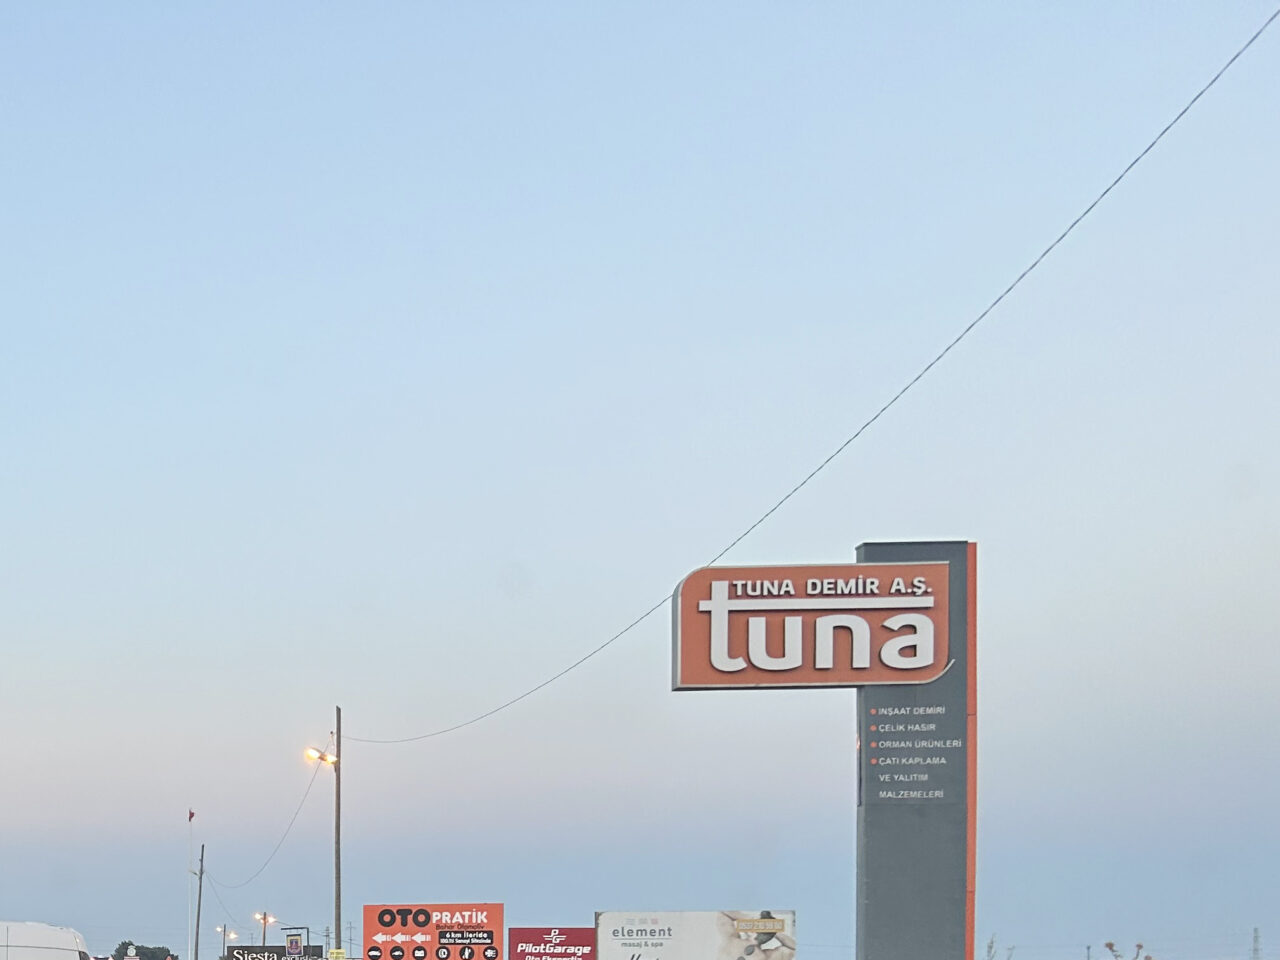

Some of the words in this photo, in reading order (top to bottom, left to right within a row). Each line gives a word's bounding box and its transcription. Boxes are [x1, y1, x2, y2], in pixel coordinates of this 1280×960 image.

[733, 579, 796, 596] TUNA
[807, 575, 880, 595] DEMİR
[890, 576, 933, 596] A.Ş.
[699, 580, 935, 672] tuna
[878, 723, 906, 732] ÇELİK
[907, 723, 936, 731] HASIR
[878, 740, 913, 748] ORMAN
[879, 789, 945, 798] MALZEMELERİ
[377, 908, 431, 928] OTO
[431, 909, 488, 924] PRATİK
[612, 926, 672, 937] element
[517, 943, 592, 956] PilotGarage
[621, 940, 642, 948] masaj
